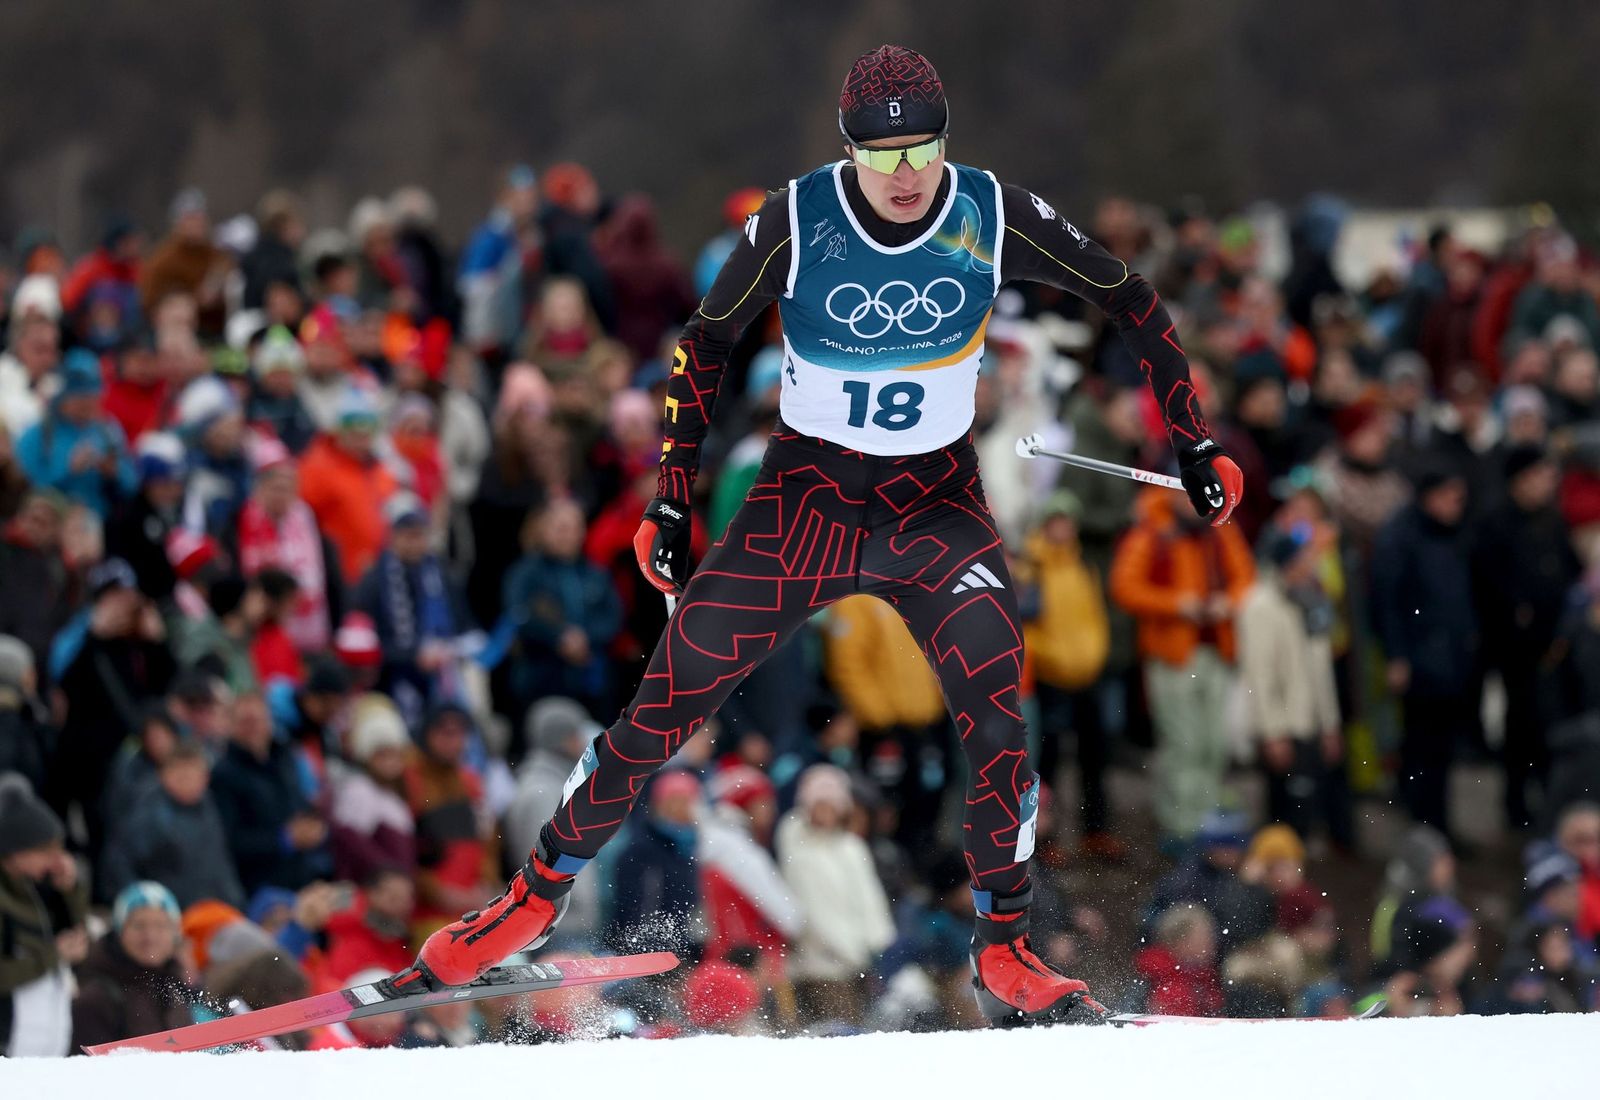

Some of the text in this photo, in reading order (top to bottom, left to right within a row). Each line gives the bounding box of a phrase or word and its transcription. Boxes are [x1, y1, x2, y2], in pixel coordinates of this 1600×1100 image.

[889, 101, 901, 117] D
[819, 338, 876, 356] MILANO
[939, 331, 963, 346] 2026
[842, 380, 925, 431] 18
